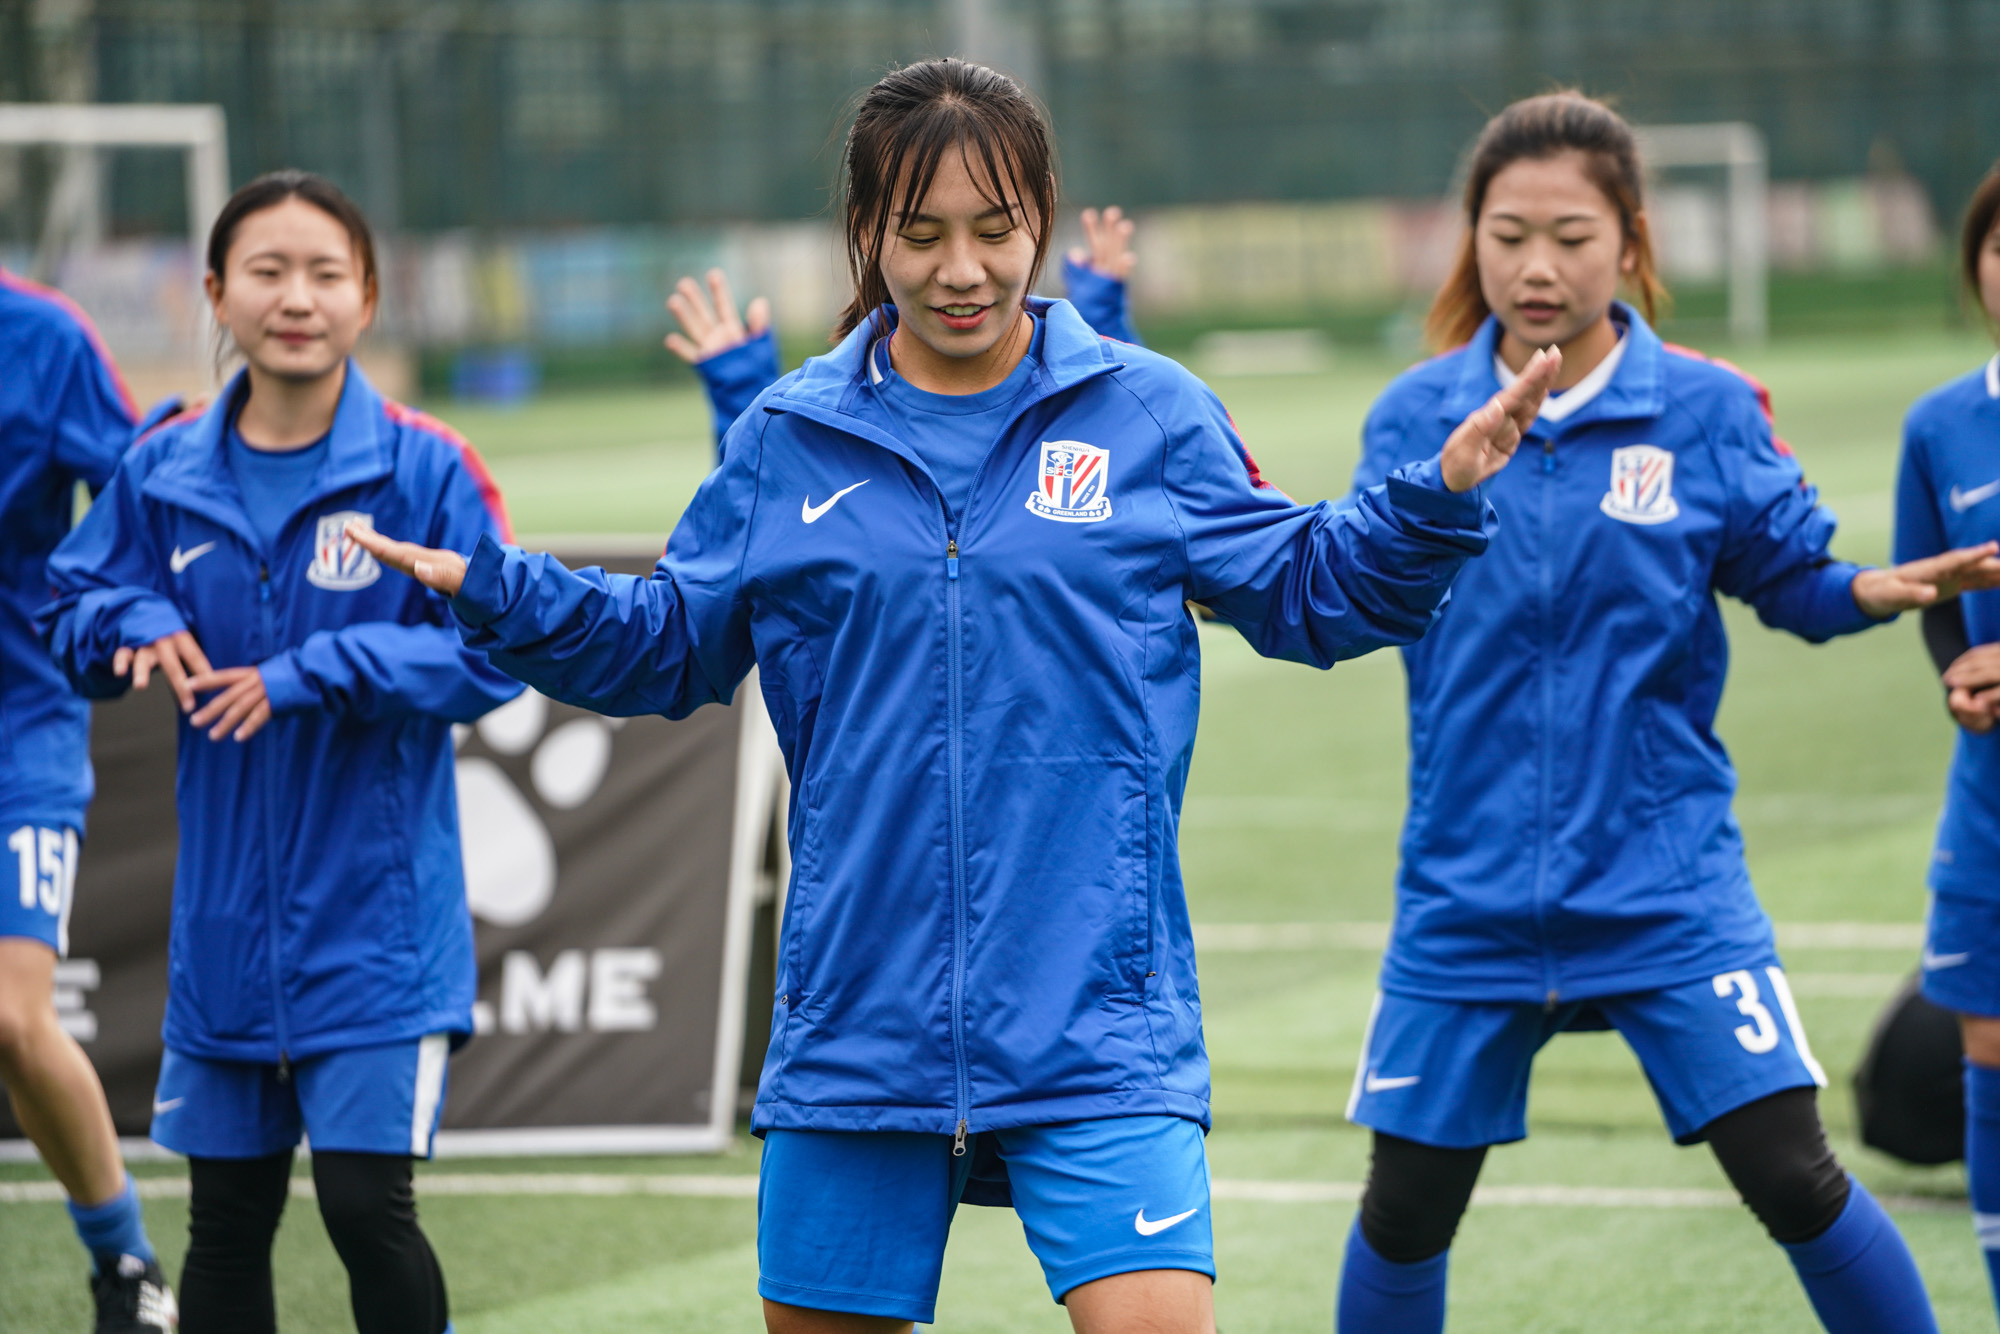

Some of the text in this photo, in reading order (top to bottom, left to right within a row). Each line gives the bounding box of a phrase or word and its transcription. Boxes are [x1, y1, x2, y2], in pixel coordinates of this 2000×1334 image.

[1046, 466, 1073, 476] SFC
[1052, 508, 1088, 517] GREENLAND
[8, 825, 64, 915] 15
[1712, 969, 1779, 1054] 3
